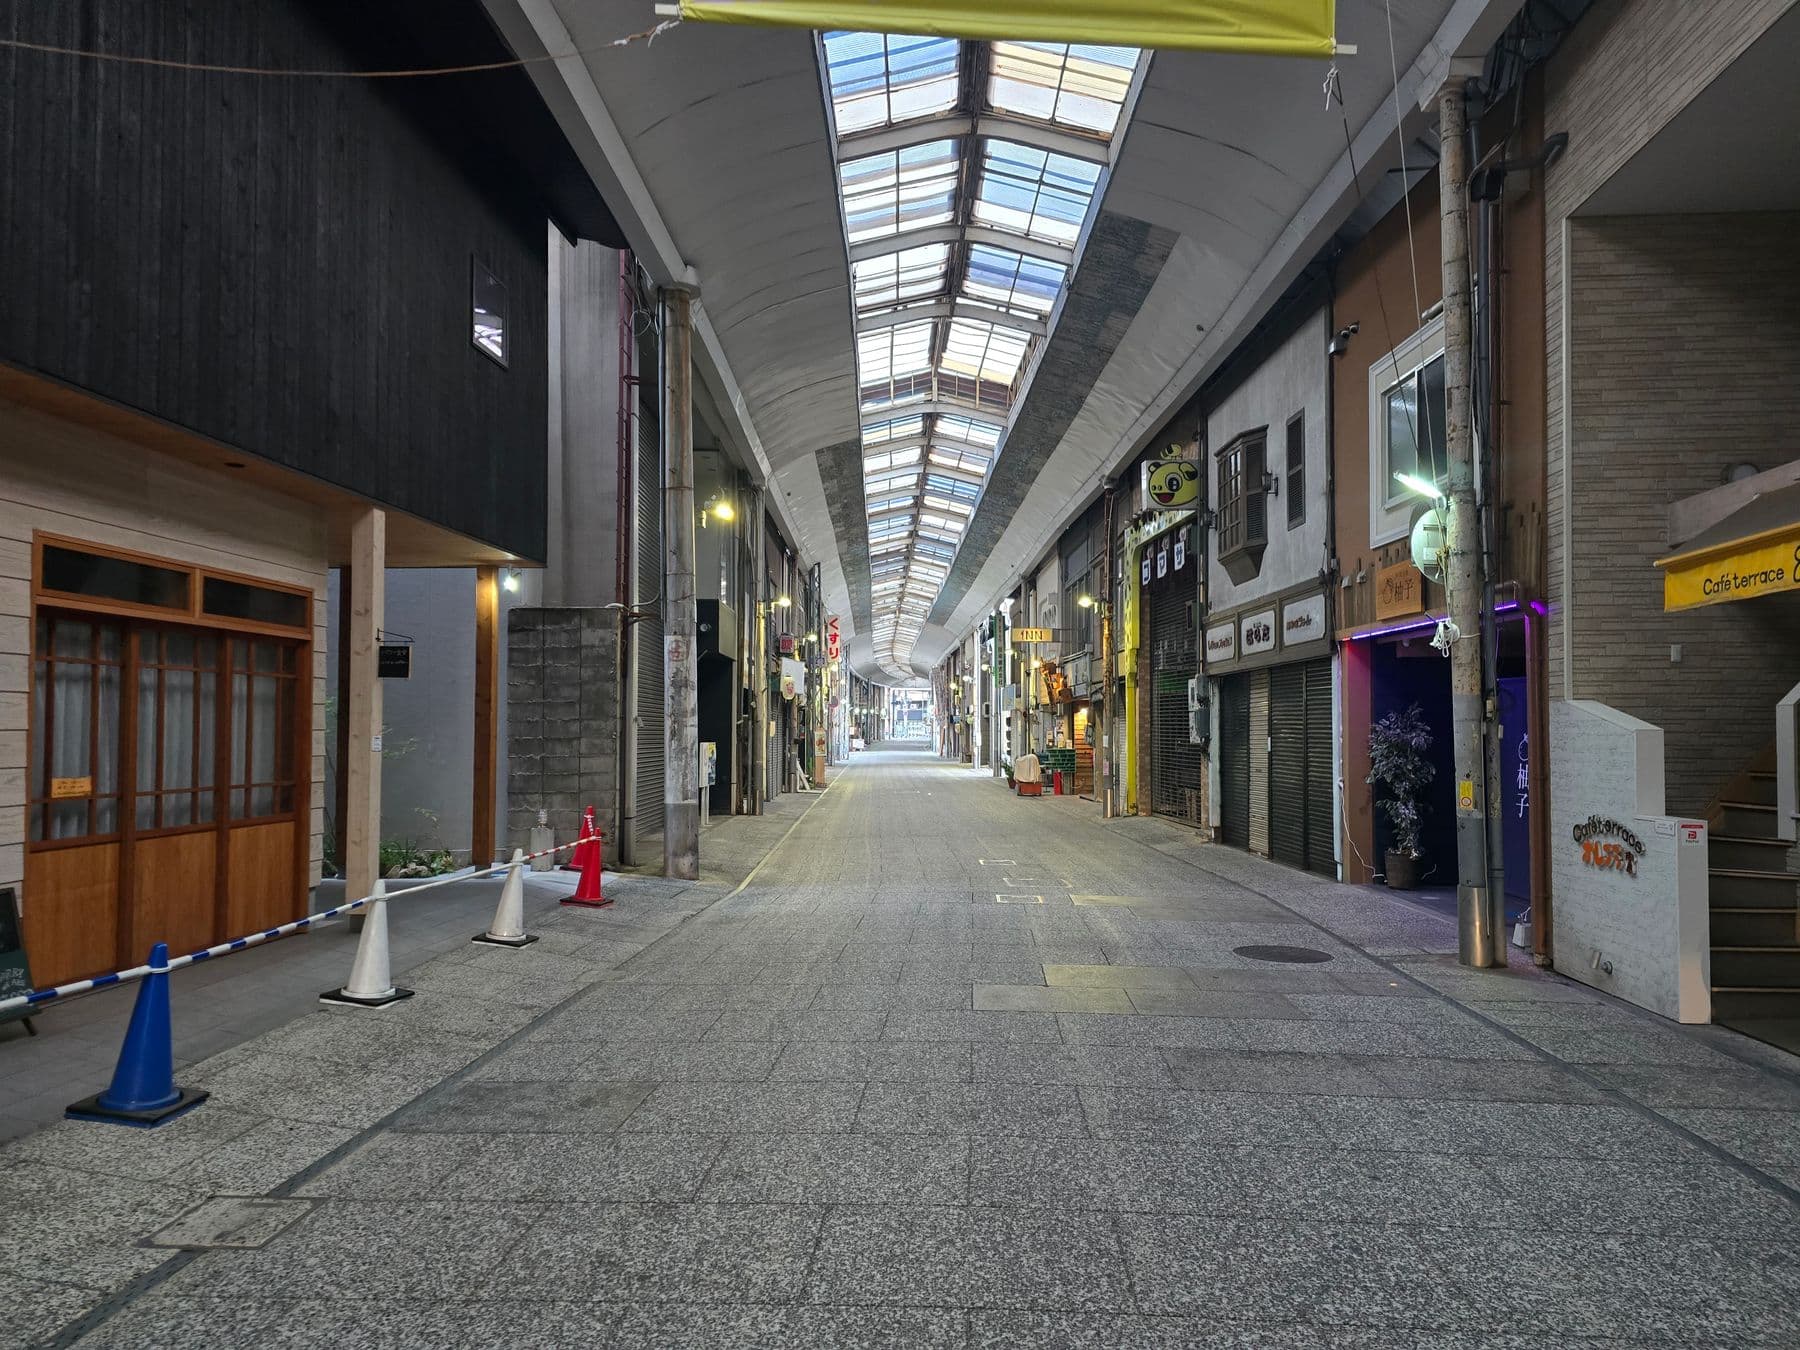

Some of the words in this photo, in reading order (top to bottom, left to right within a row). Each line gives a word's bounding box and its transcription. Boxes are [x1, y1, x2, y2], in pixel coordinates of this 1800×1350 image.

[1703, 573, 1731, 596] Café
[1733, 567, 1785, 590] terrace
[828, 617, 840, 660] くすり
